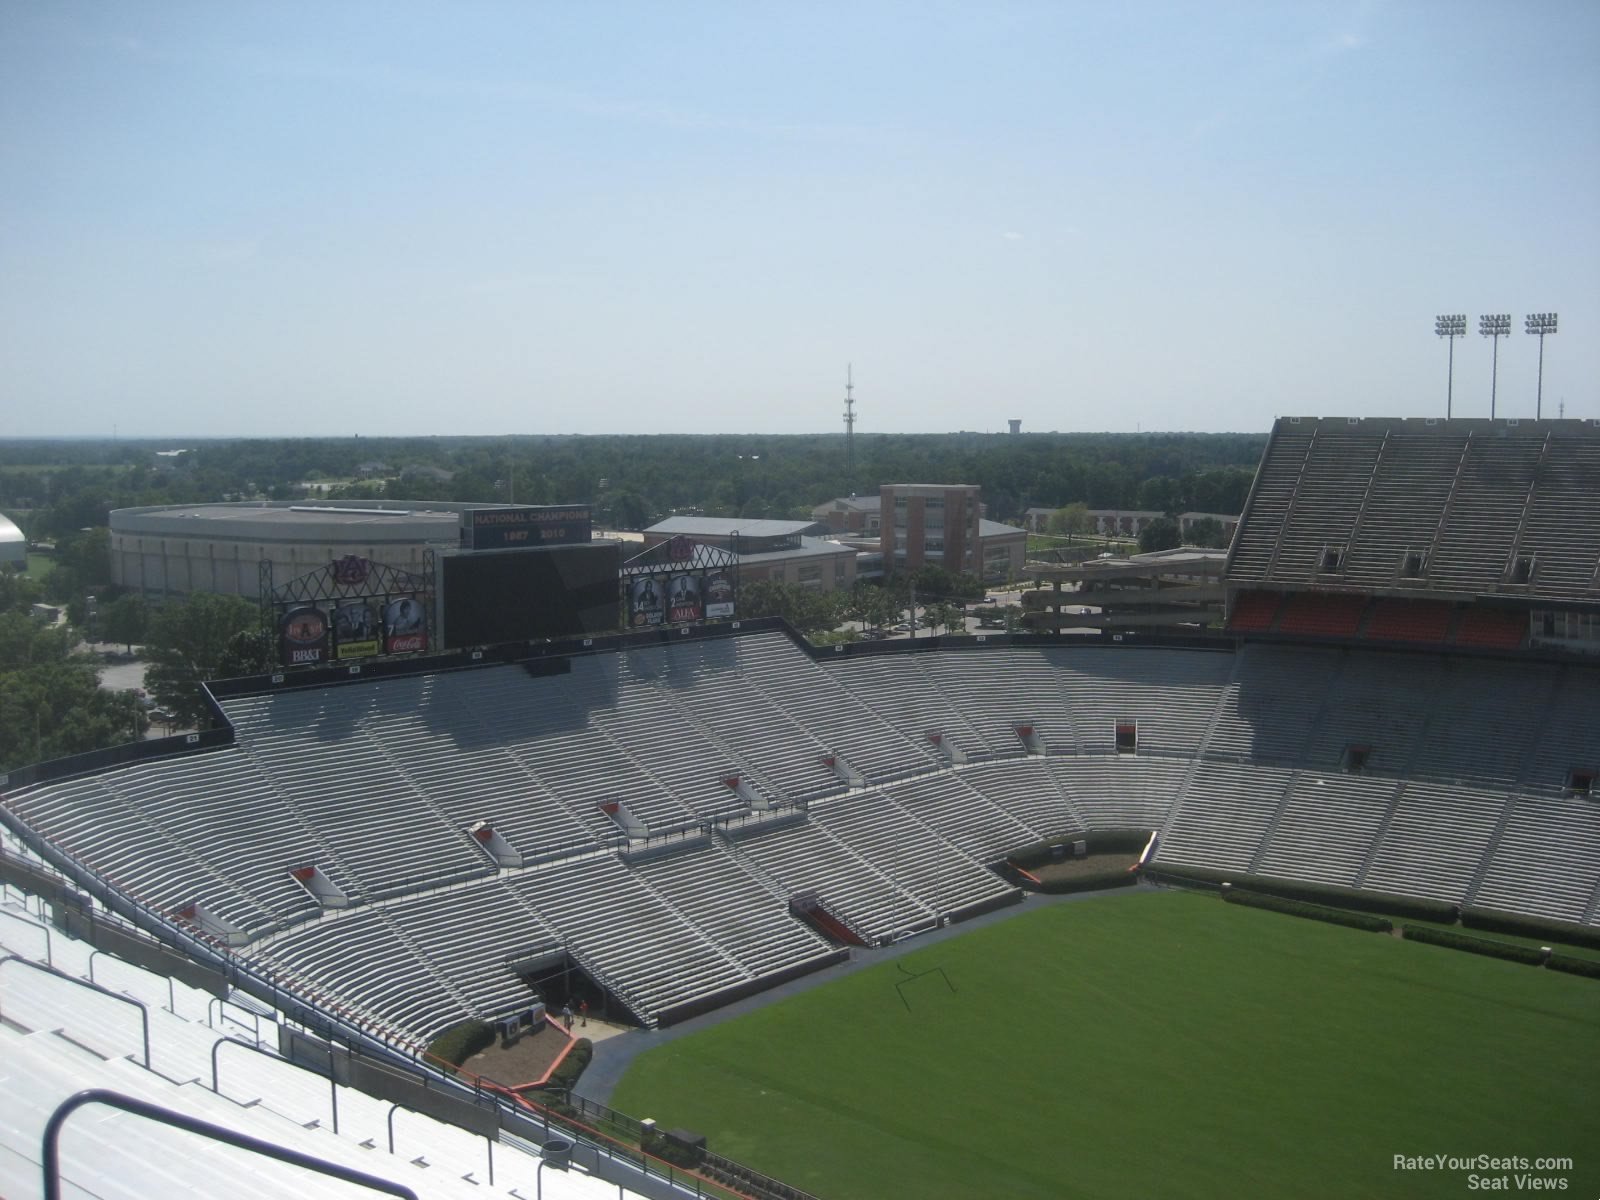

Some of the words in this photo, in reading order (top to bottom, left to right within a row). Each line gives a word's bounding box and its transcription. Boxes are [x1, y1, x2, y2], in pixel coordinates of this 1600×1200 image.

[475, 512, 527, 525] NATIONAL
[530, 510, 589, 521] CHAMPIONS
[541, 529, 565, 538] 2010
[634, 601, 644, 612] 34
[388, 624, 394, 637] 7
[293, 649, 322, 662] BB&T
